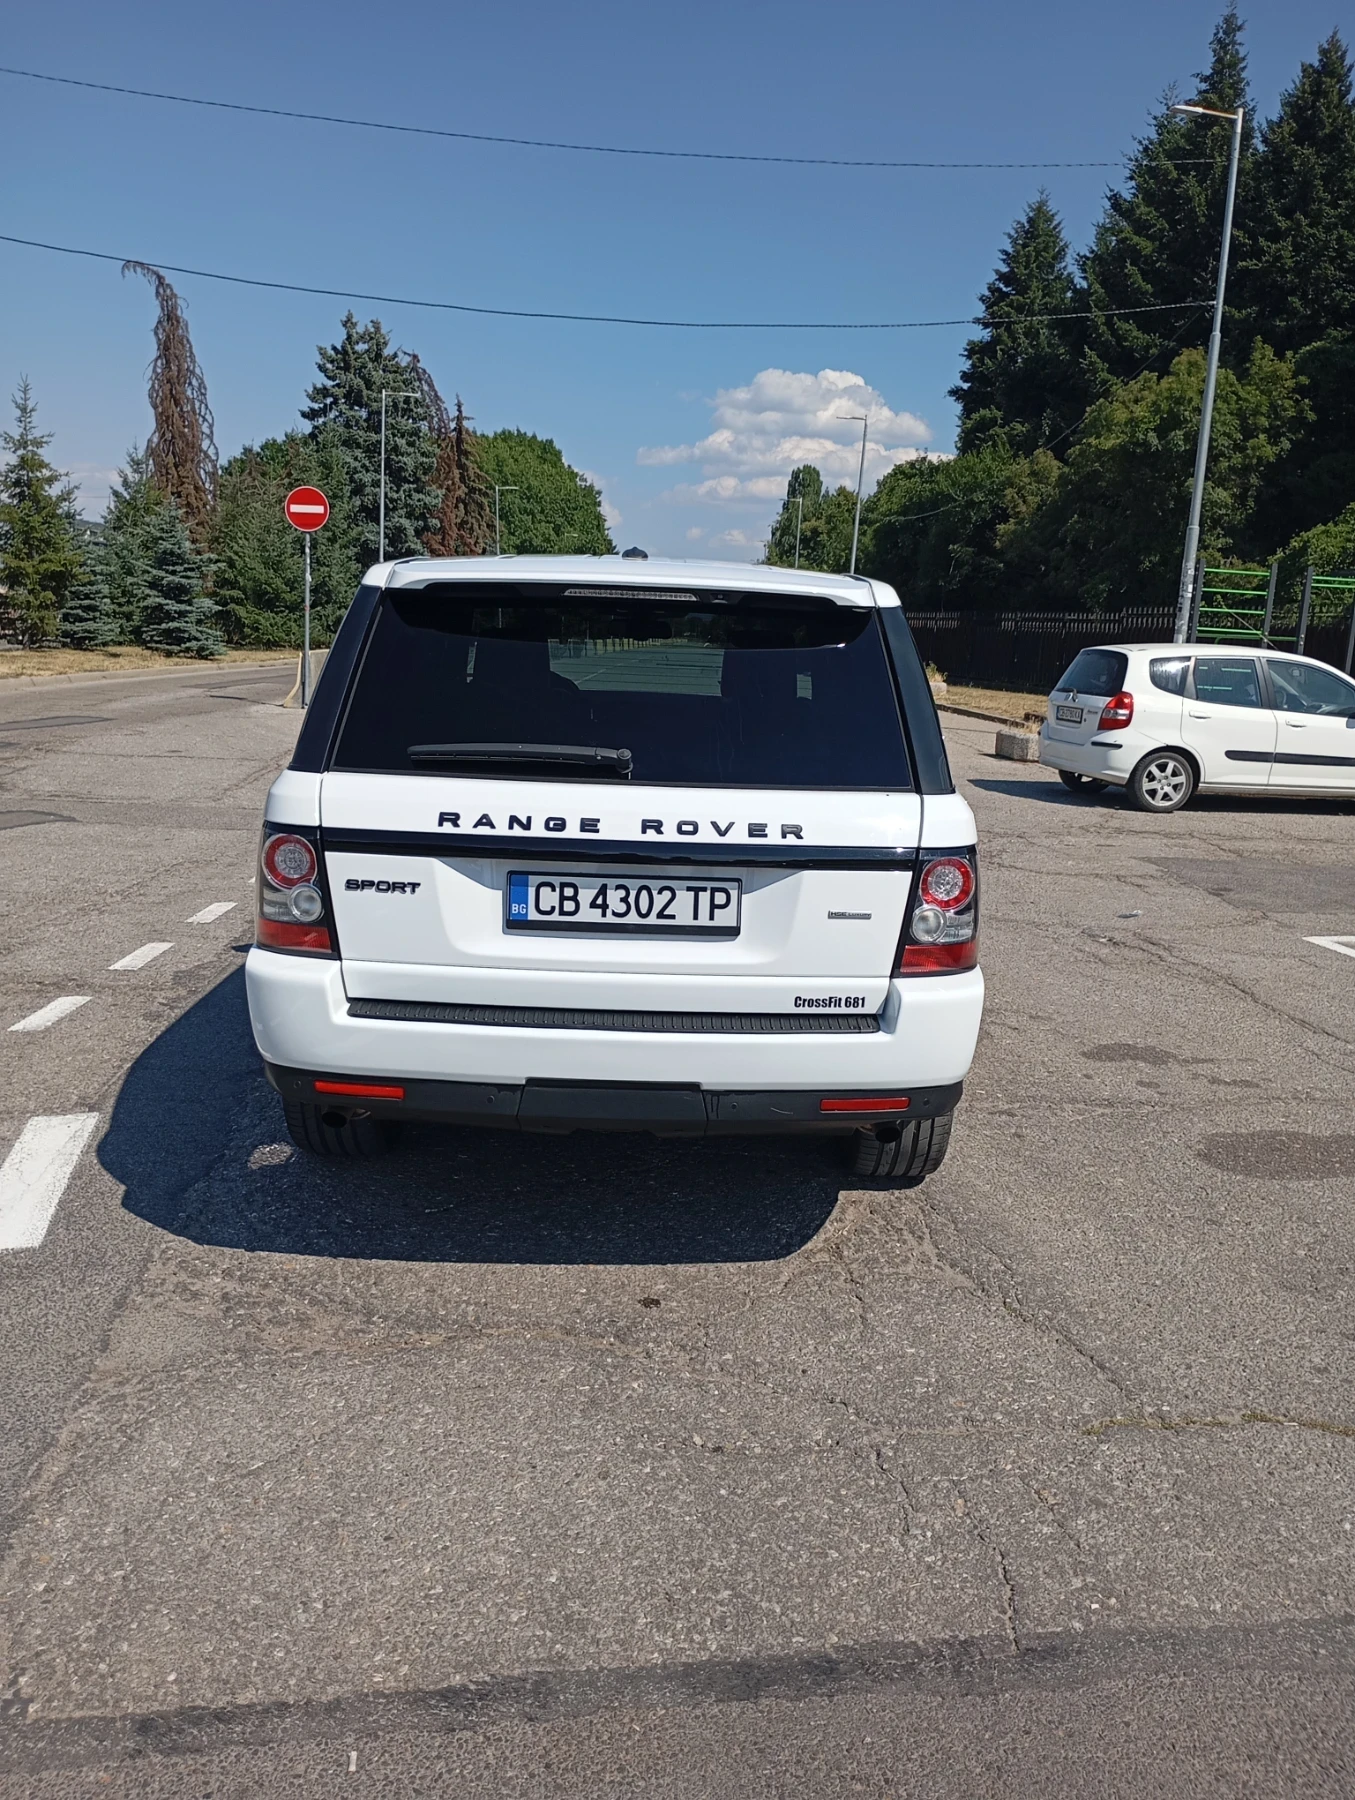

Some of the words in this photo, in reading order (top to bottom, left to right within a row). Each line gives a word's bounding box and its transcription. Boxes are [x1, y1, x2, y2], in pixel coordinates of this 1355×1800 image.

[437, 811, 601, 833] RANGE
[641, 818, 805, 840] ROVER
[344, 879, 421, 894] SPORT
[511, 903, 527, 914] BG
[534, 881, 581, 917] CB
[589, 883, 677, 920] 4302
[686, 886, 732, 921] TP
[794, 995, 842, 1008] CrossFit
[844, 996, 866, 1008] 681
